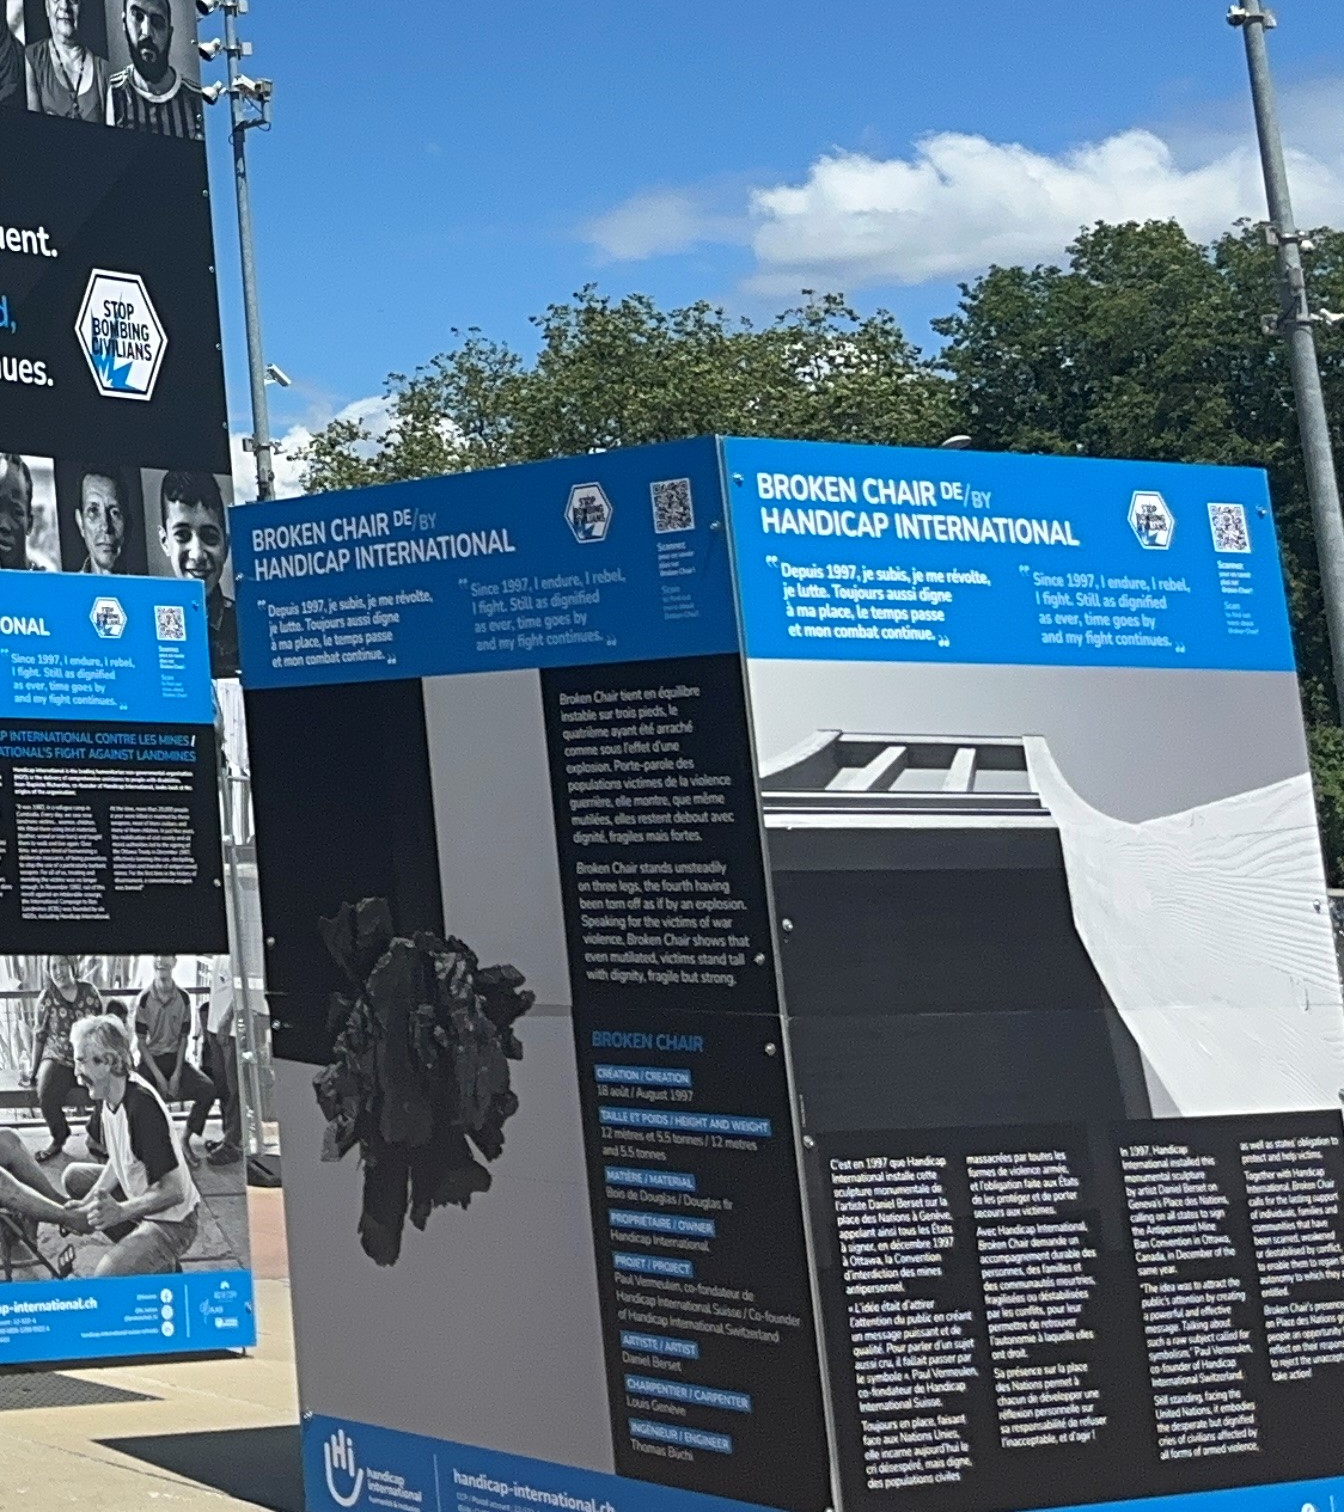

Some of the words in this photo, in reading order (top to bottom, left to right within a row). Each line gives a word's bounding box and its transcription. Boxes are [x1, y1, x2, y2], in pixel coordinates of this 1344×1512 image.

[103, 299, 134, 320] STOP
[91, 316, 149, 343] BOMBING
[91, 336, 153, 362] CIVILIANS
[757, 472, 857, 505] BROKEN
[862, 477, 937, 507] CHAIR
[252, 517, 326, 552] BROKEN
[330, 511, 389, 546] CHAIR
[761, 508, 889, 539] HANDICAP
[895, 513, 1080, 548] INTERNATIONAL
[255, 548, 351, 582] HANDICAP
[355, 528, 515, 571] INTERNATIONAL
[860, 562, 875, 584] je
[910, 564, 924, 587] je
[925, 569, 945, 588] me
[10, 730, 93, 744] INTERNATIONAL
[94, 733, 137, 745] CONTRE
[139, 734, 157, 745] LES
[158, 734, 189, 746] MINES
[55, 747, 85, 760] FIGHT
[89, 747, 134, 761] AGAINST
[136, 749, 196, 763] LANDMINES
[592, 1031, 653, 1050] BROKEN
[656, 1034, 703, 1053] CHAIR
